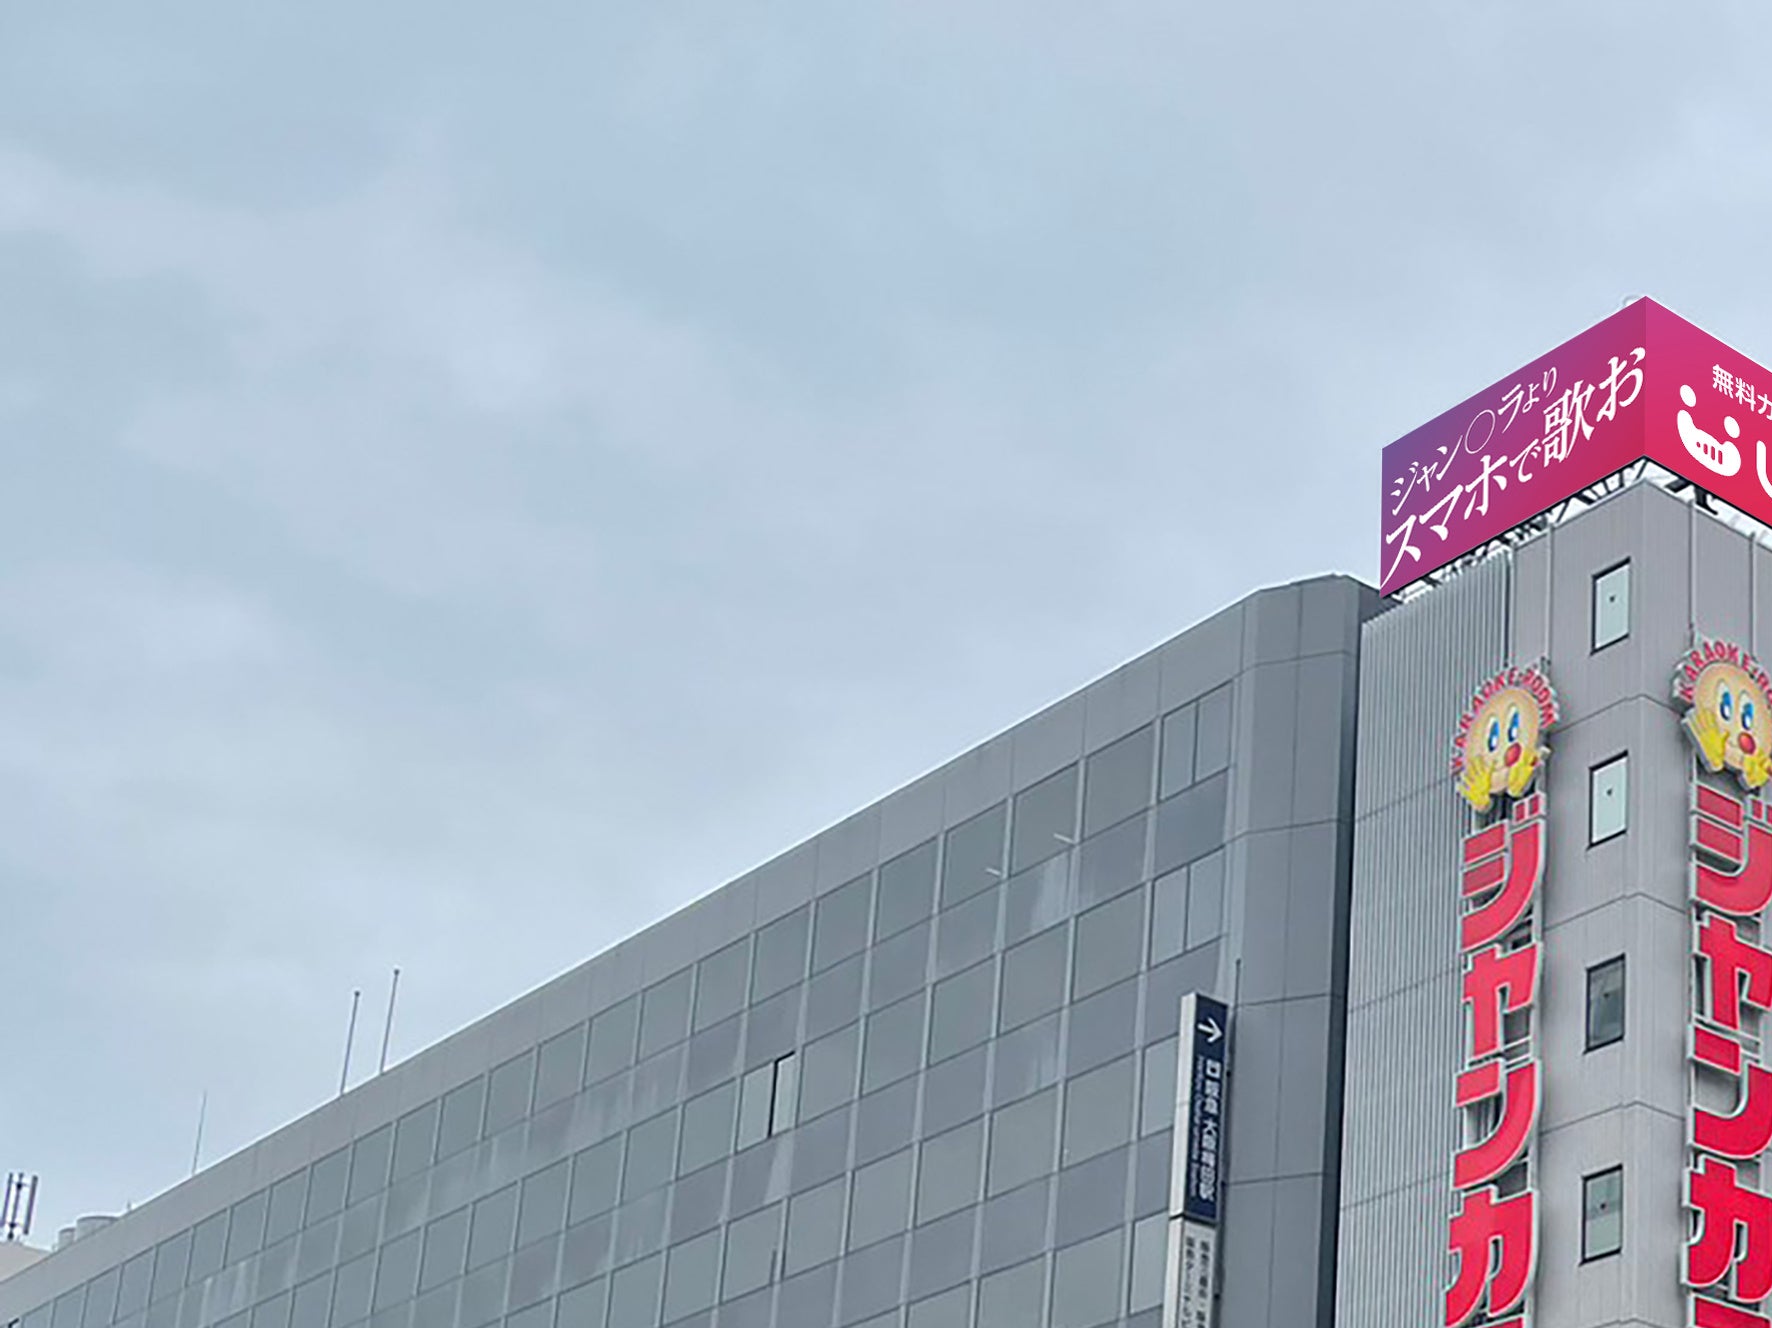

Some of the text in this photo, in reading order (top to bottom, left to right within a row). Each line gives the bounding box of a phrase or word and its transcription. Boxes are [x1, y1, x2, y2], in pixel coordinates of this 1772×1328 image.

[1381, 346, 1646, 590] スマホで歌お
